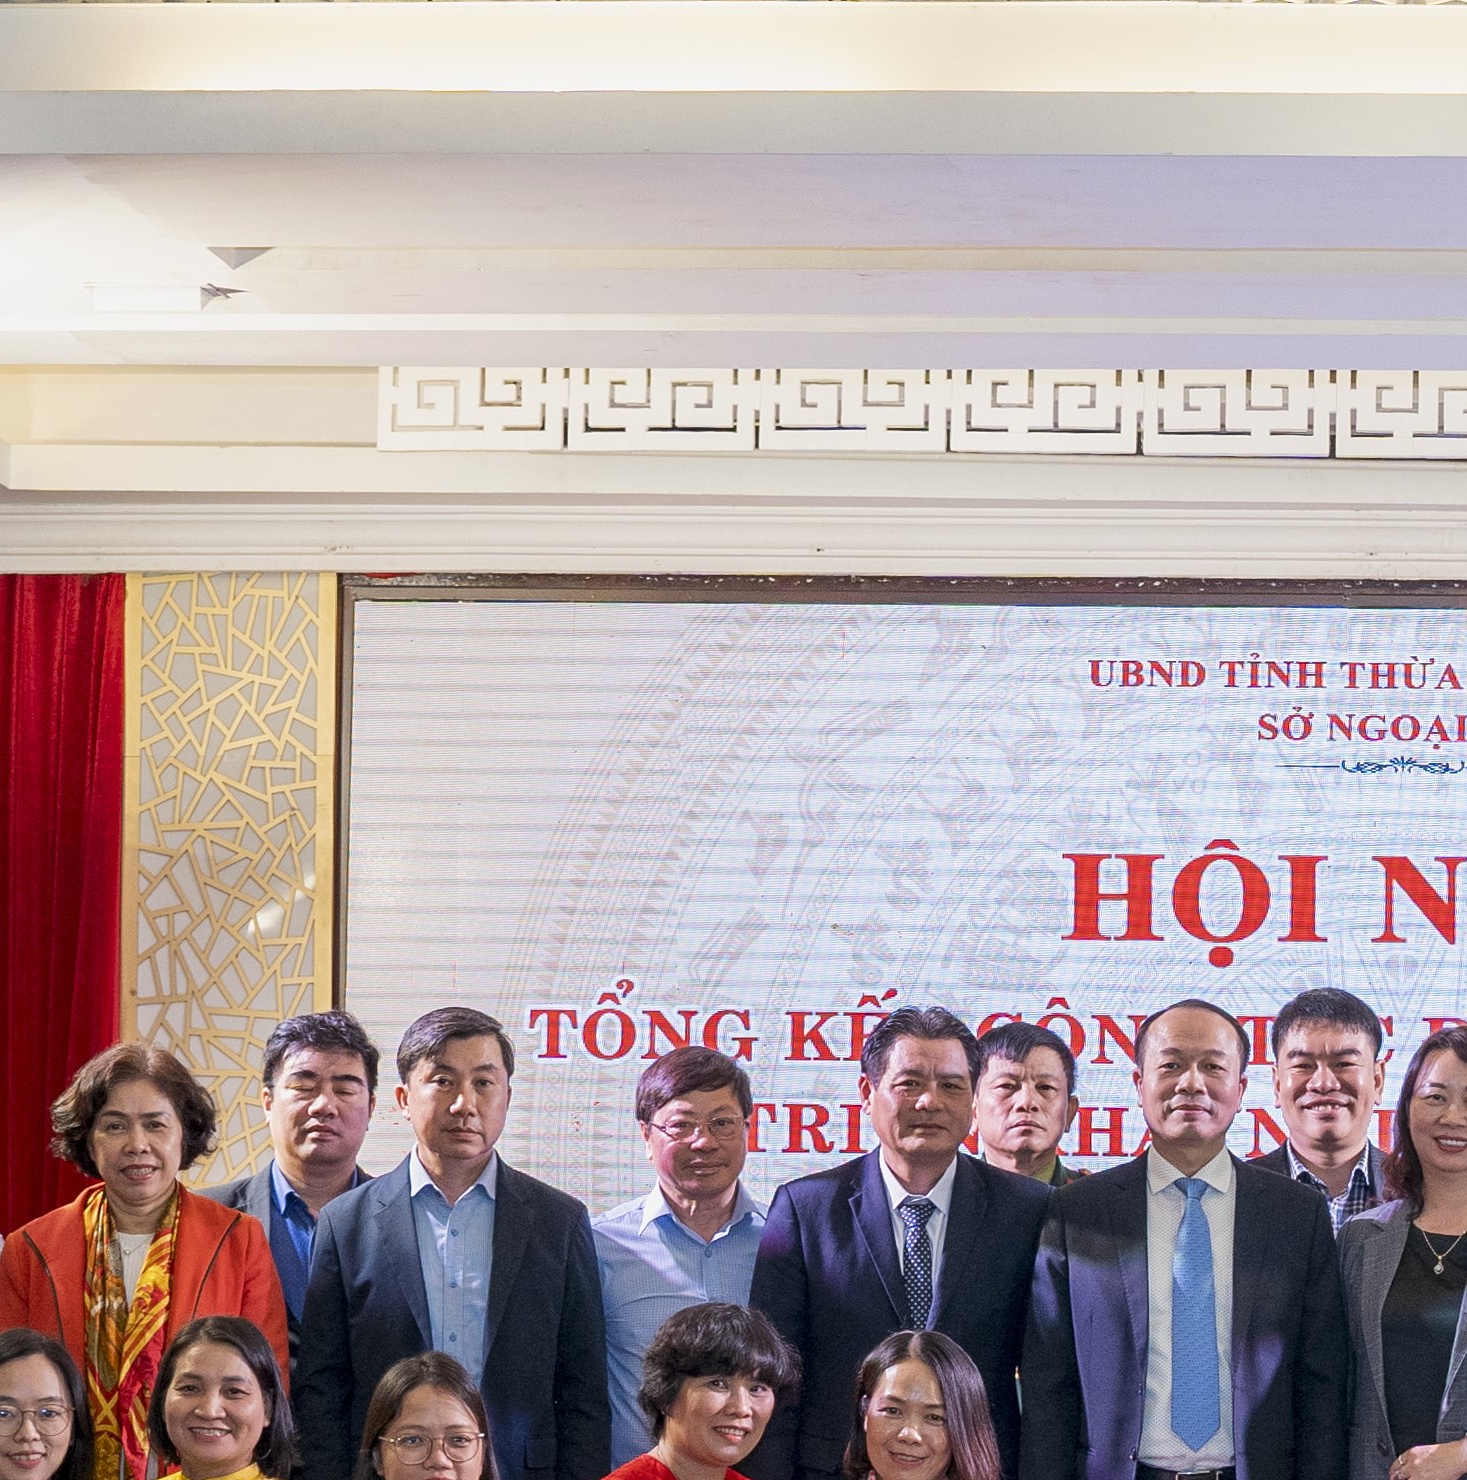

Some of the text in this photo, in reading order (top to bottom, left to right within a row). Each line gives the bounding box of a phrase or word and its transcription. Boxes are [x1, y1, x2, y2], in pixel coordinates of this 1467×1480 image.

[1088, 659, 1206, 688] UBND
[1219, 655, 1326, 689] TỈNH
[1340, 657, 1464, 690] THỪA
[1257, 706, 1316, 741] SỞ
[1327, 713, 1467, 747] NGOẠI
[1061, 839, 1328, 967] HỘI
[529, 978, 758, 1061] TỔNG
[785, 988, 897, 1061] KẾ
